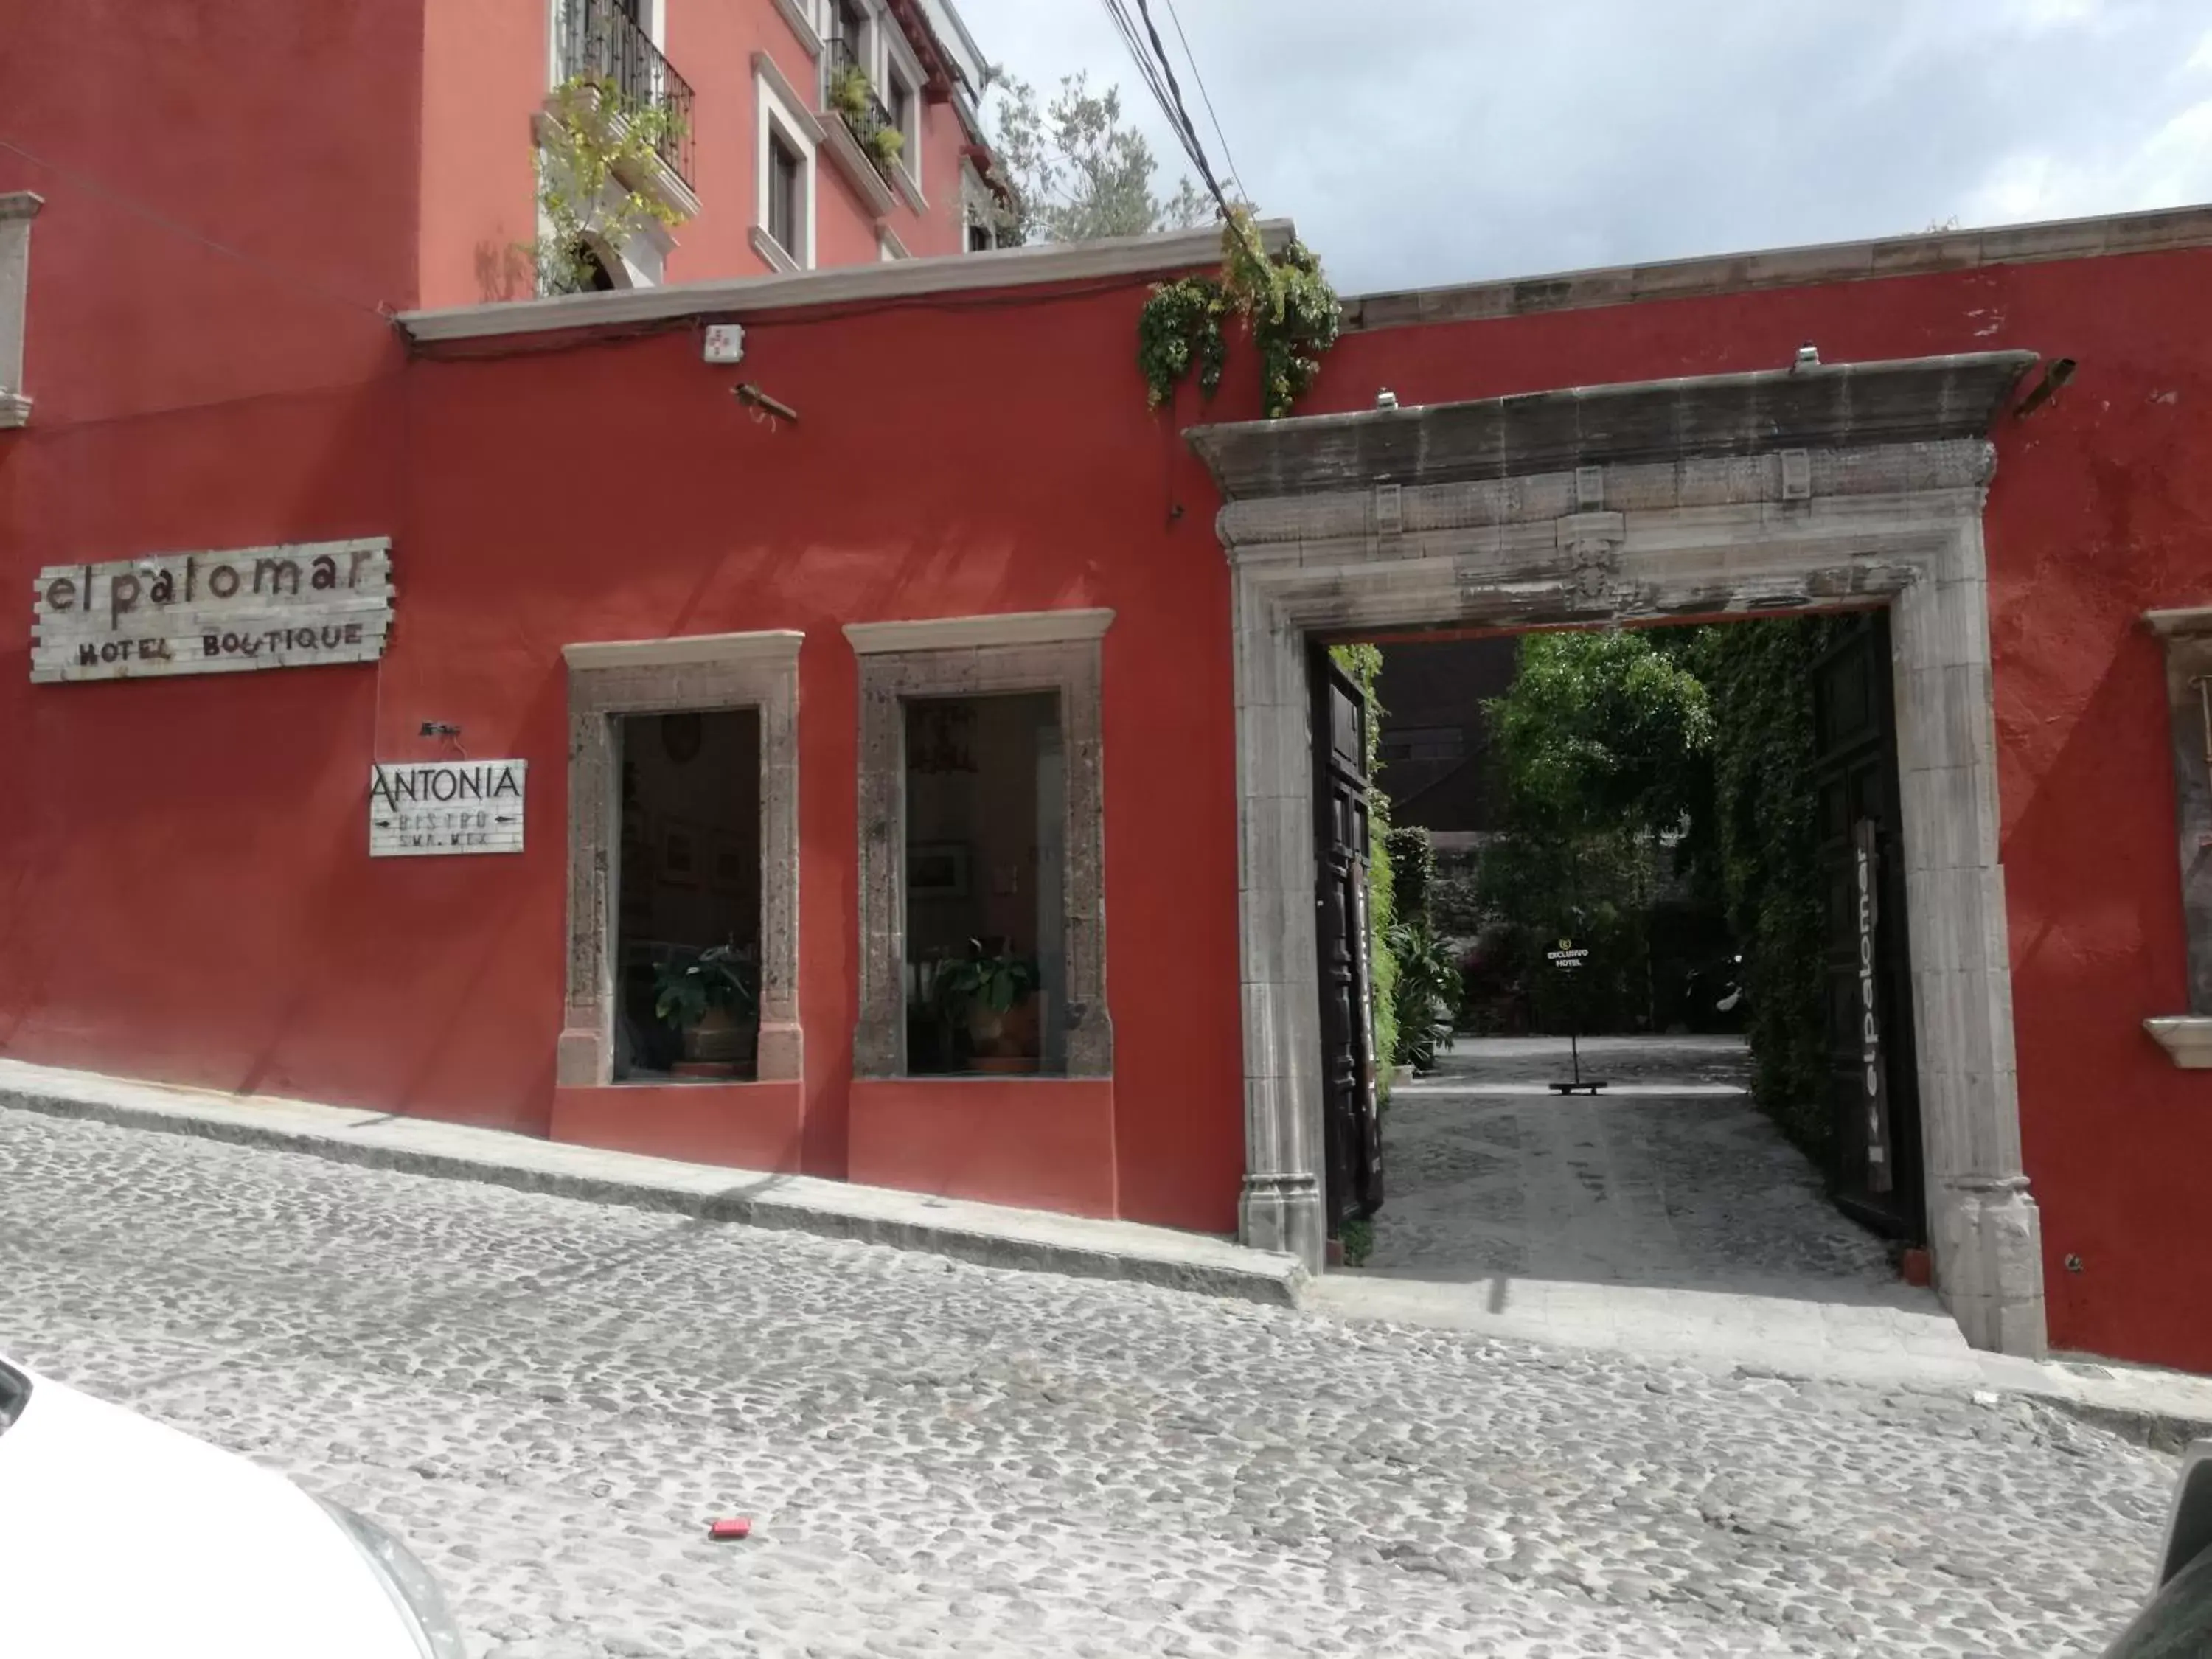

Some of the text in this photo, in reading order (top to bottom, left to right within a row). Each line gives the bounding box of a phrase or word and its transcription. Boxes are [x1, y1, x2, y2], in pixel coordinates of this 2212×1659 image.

[79, 623, 363, 666] HOTEL BOUTIQUE
[370, 765, 520, 812] ANTONIA
[1548, 950, 1588, 959] EXCLUSIVO
